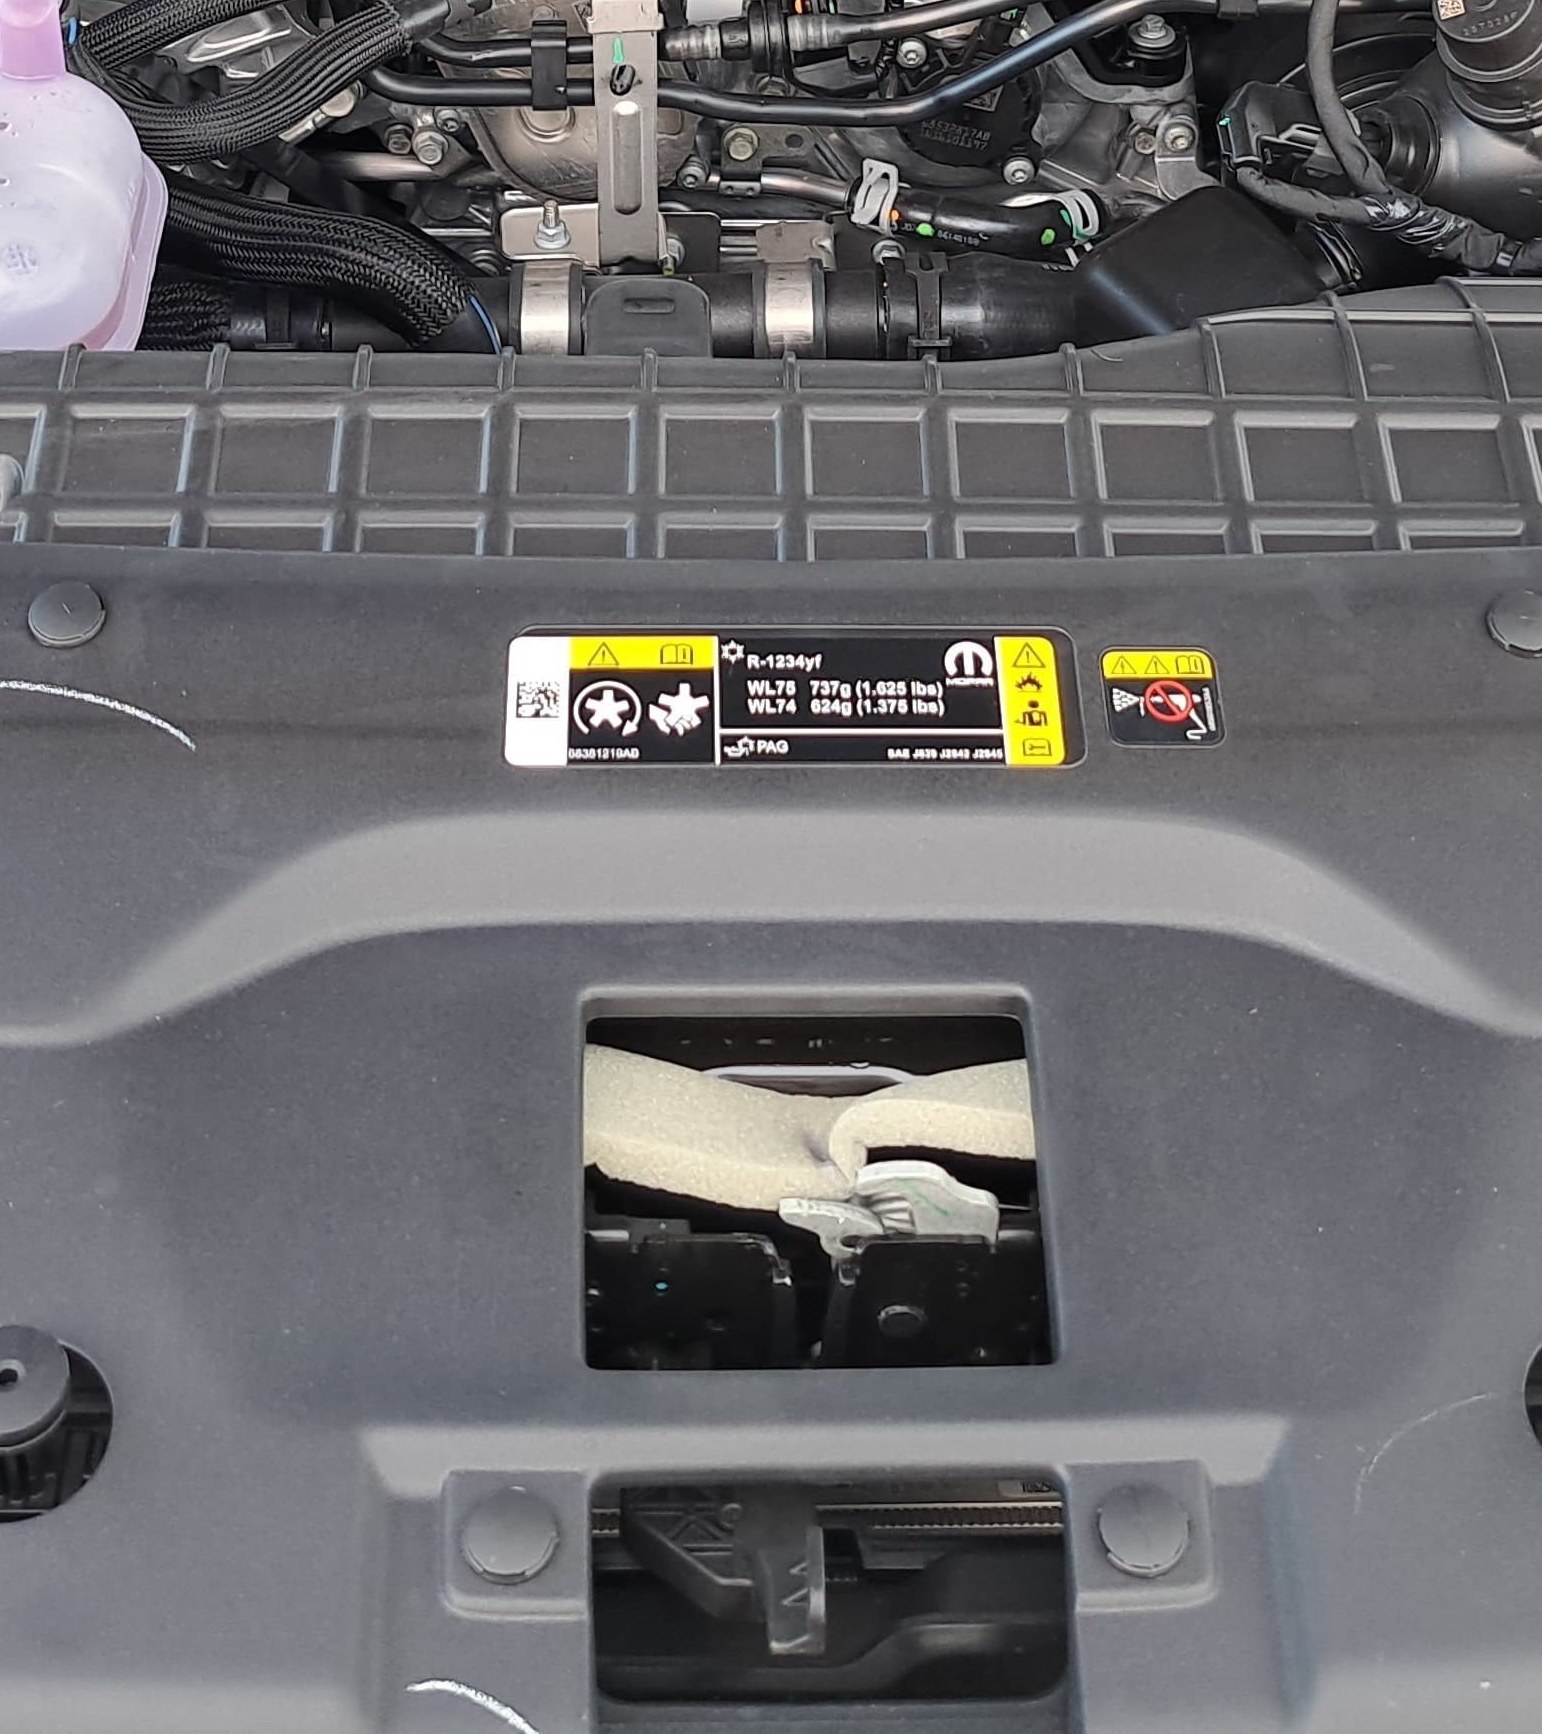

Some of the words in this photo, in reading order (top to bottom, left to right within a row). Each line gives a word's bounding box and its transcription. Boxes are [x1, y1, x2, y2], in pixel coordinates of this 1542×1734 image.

[747, 653, 823, 672] R-1234yf
[747, 680, 797, 697] WL75
[809, 680, 852, 698] 737g
[911, 680, 944, 699] lbs)
[945, 677, 994, 687] MOPAR
[747, 698, 798, 715] WL74
[810, 698, 852, 717] 624g
[856, 698, 909, 717] (1.375
[912, 698, 945, 717] lbs)
[756, 740, 790, 755] PAG
